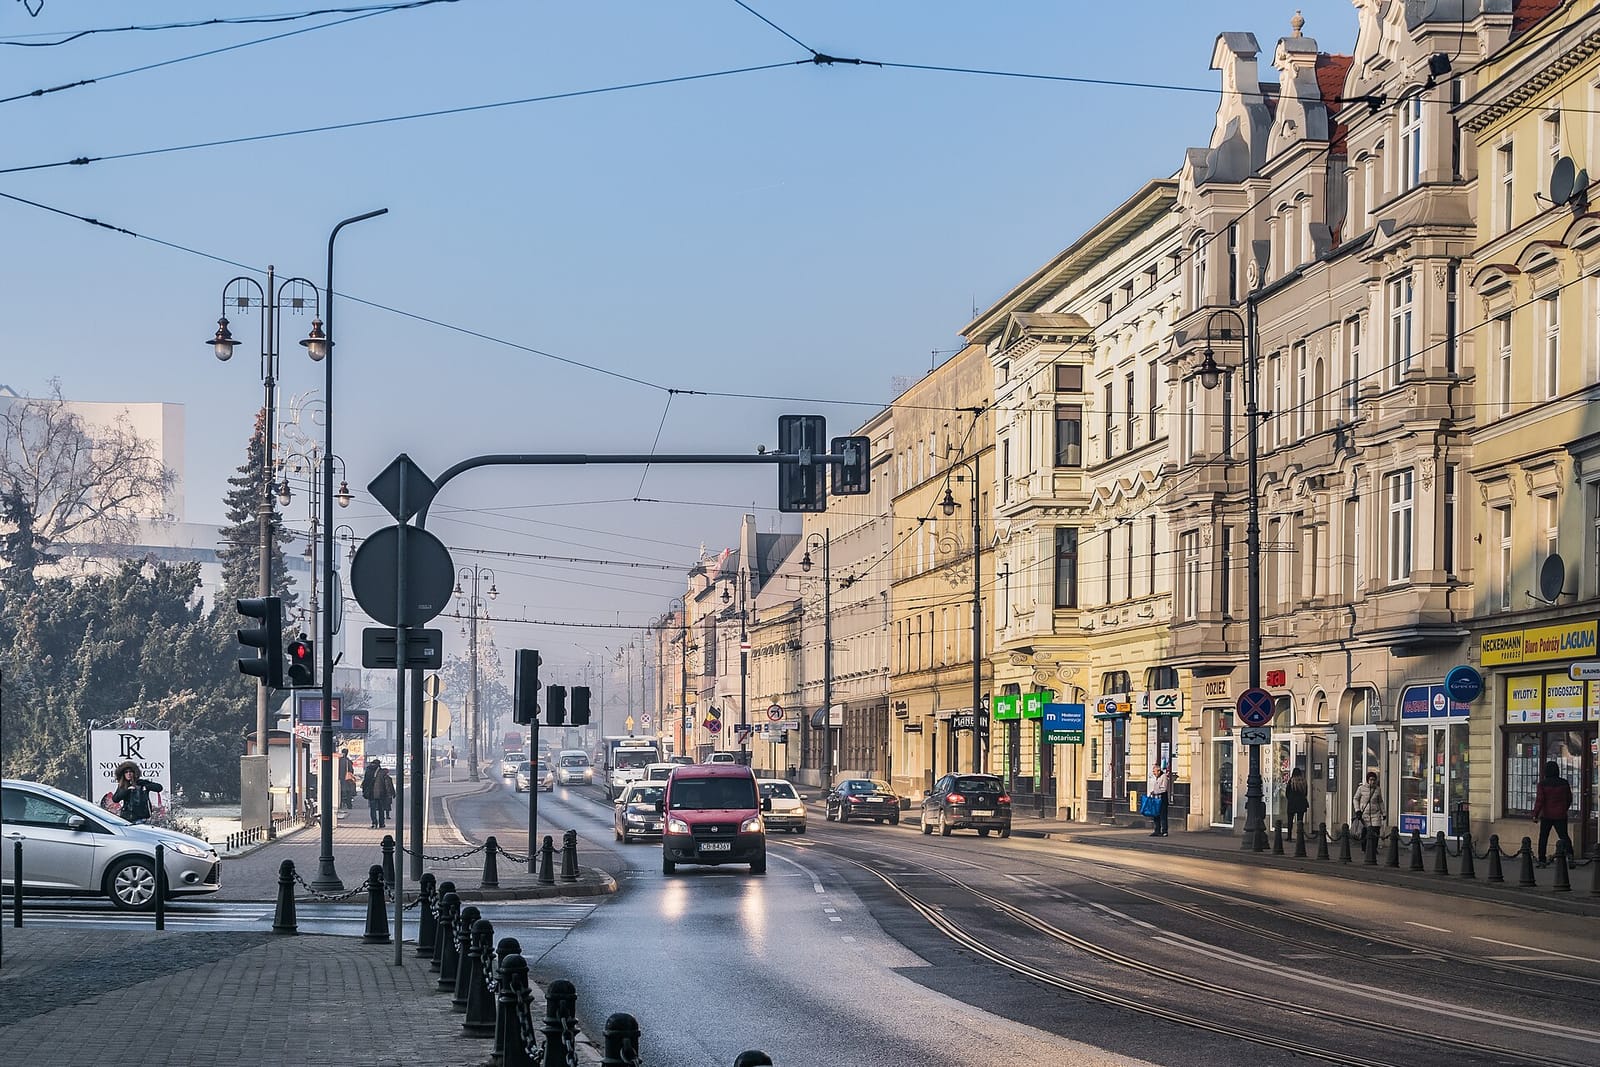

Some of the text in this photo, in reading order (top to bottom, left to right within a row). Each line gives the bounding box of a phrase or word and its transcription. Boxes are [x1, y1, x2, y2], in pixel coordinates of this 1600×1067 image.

[1482, 635, 1521, 652] NECKERMANN
[1525, 629, 1595, 653] Biuro Podróży LAGUNA
[1205, 680, 1226, 696] ODZIEŻ
[1513, 688, 1538, 699] WYLOTY Z
[1547, 686, 1583, 697] BYDGOSZCZY
[953, 716, 988, 728] MANEIN
[1048, 734, 1081, 742] Notariusz
